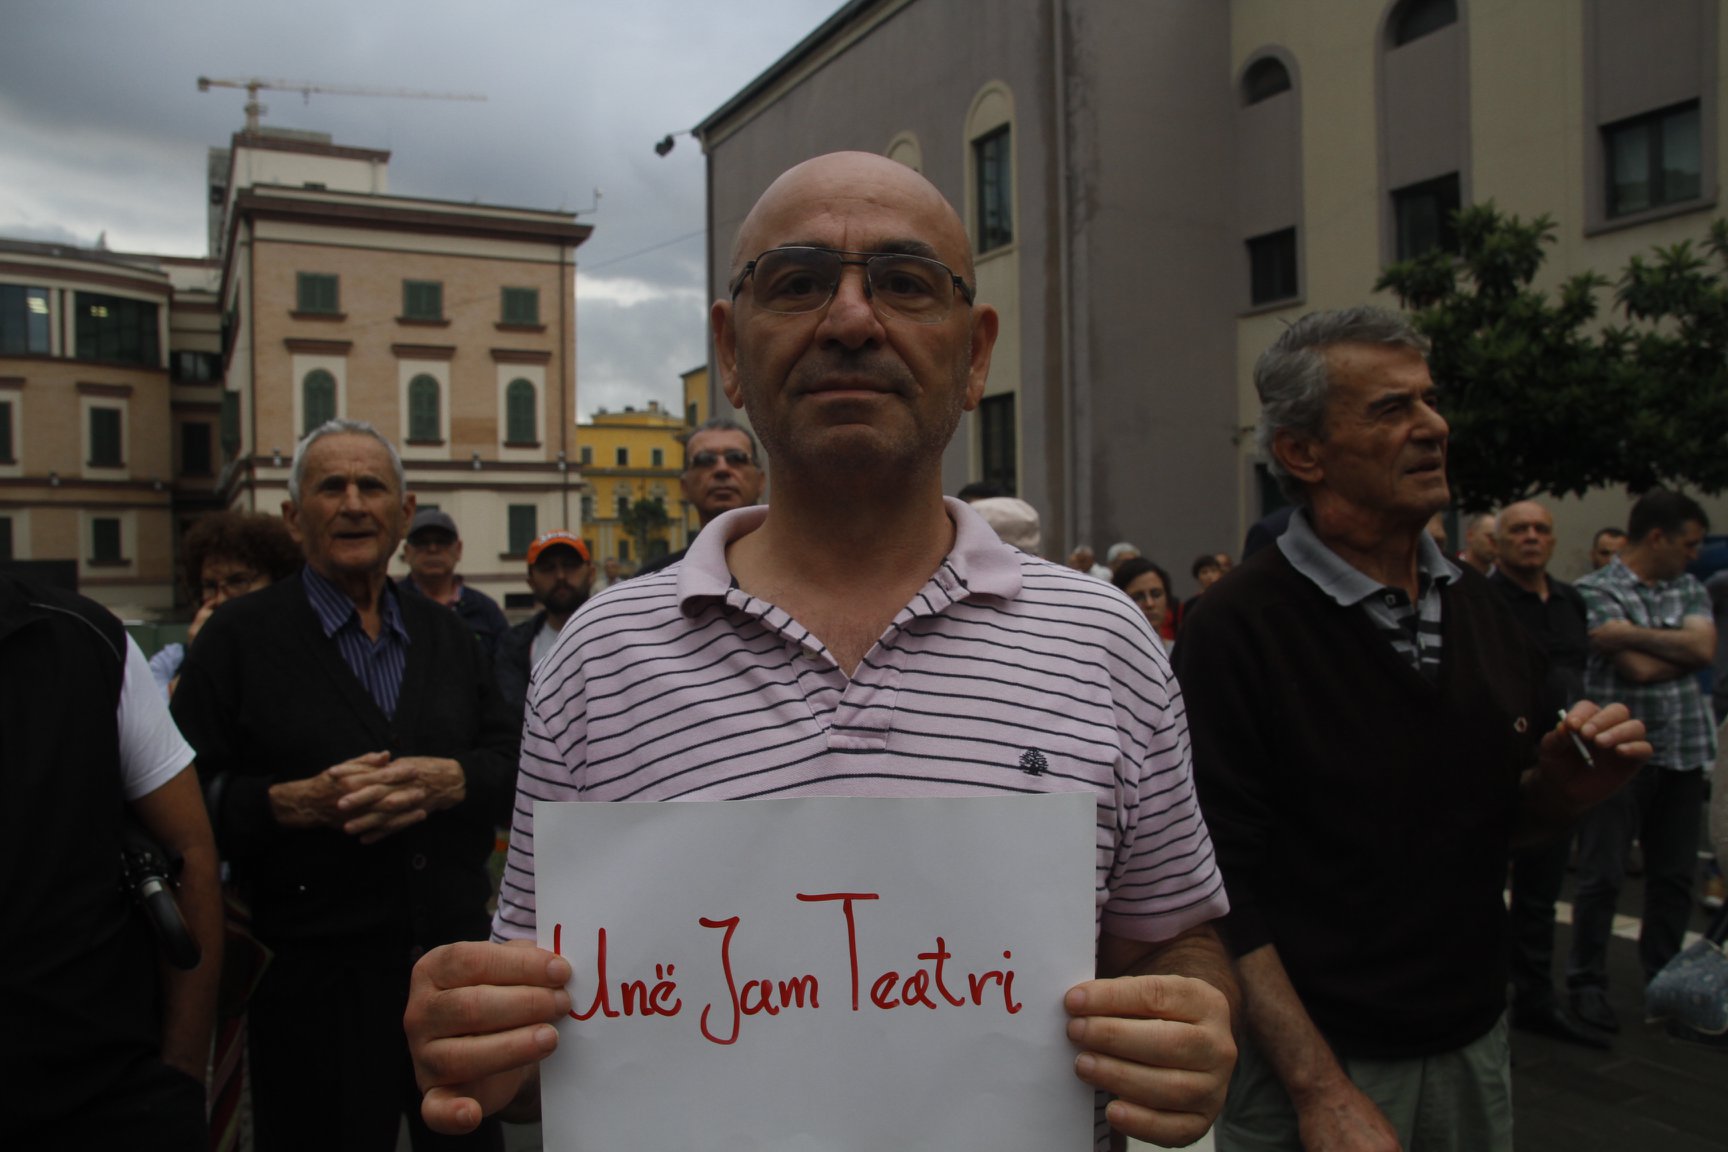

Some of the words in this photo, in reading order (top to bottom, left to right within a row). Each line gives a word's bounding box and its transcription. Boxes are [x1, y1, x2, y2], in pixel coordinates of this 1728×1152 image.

[553, 923, 682, 1021] Unë
[699, 916, 820, 1045] Jam
[796, 892, 1023, 1014] Teatri
